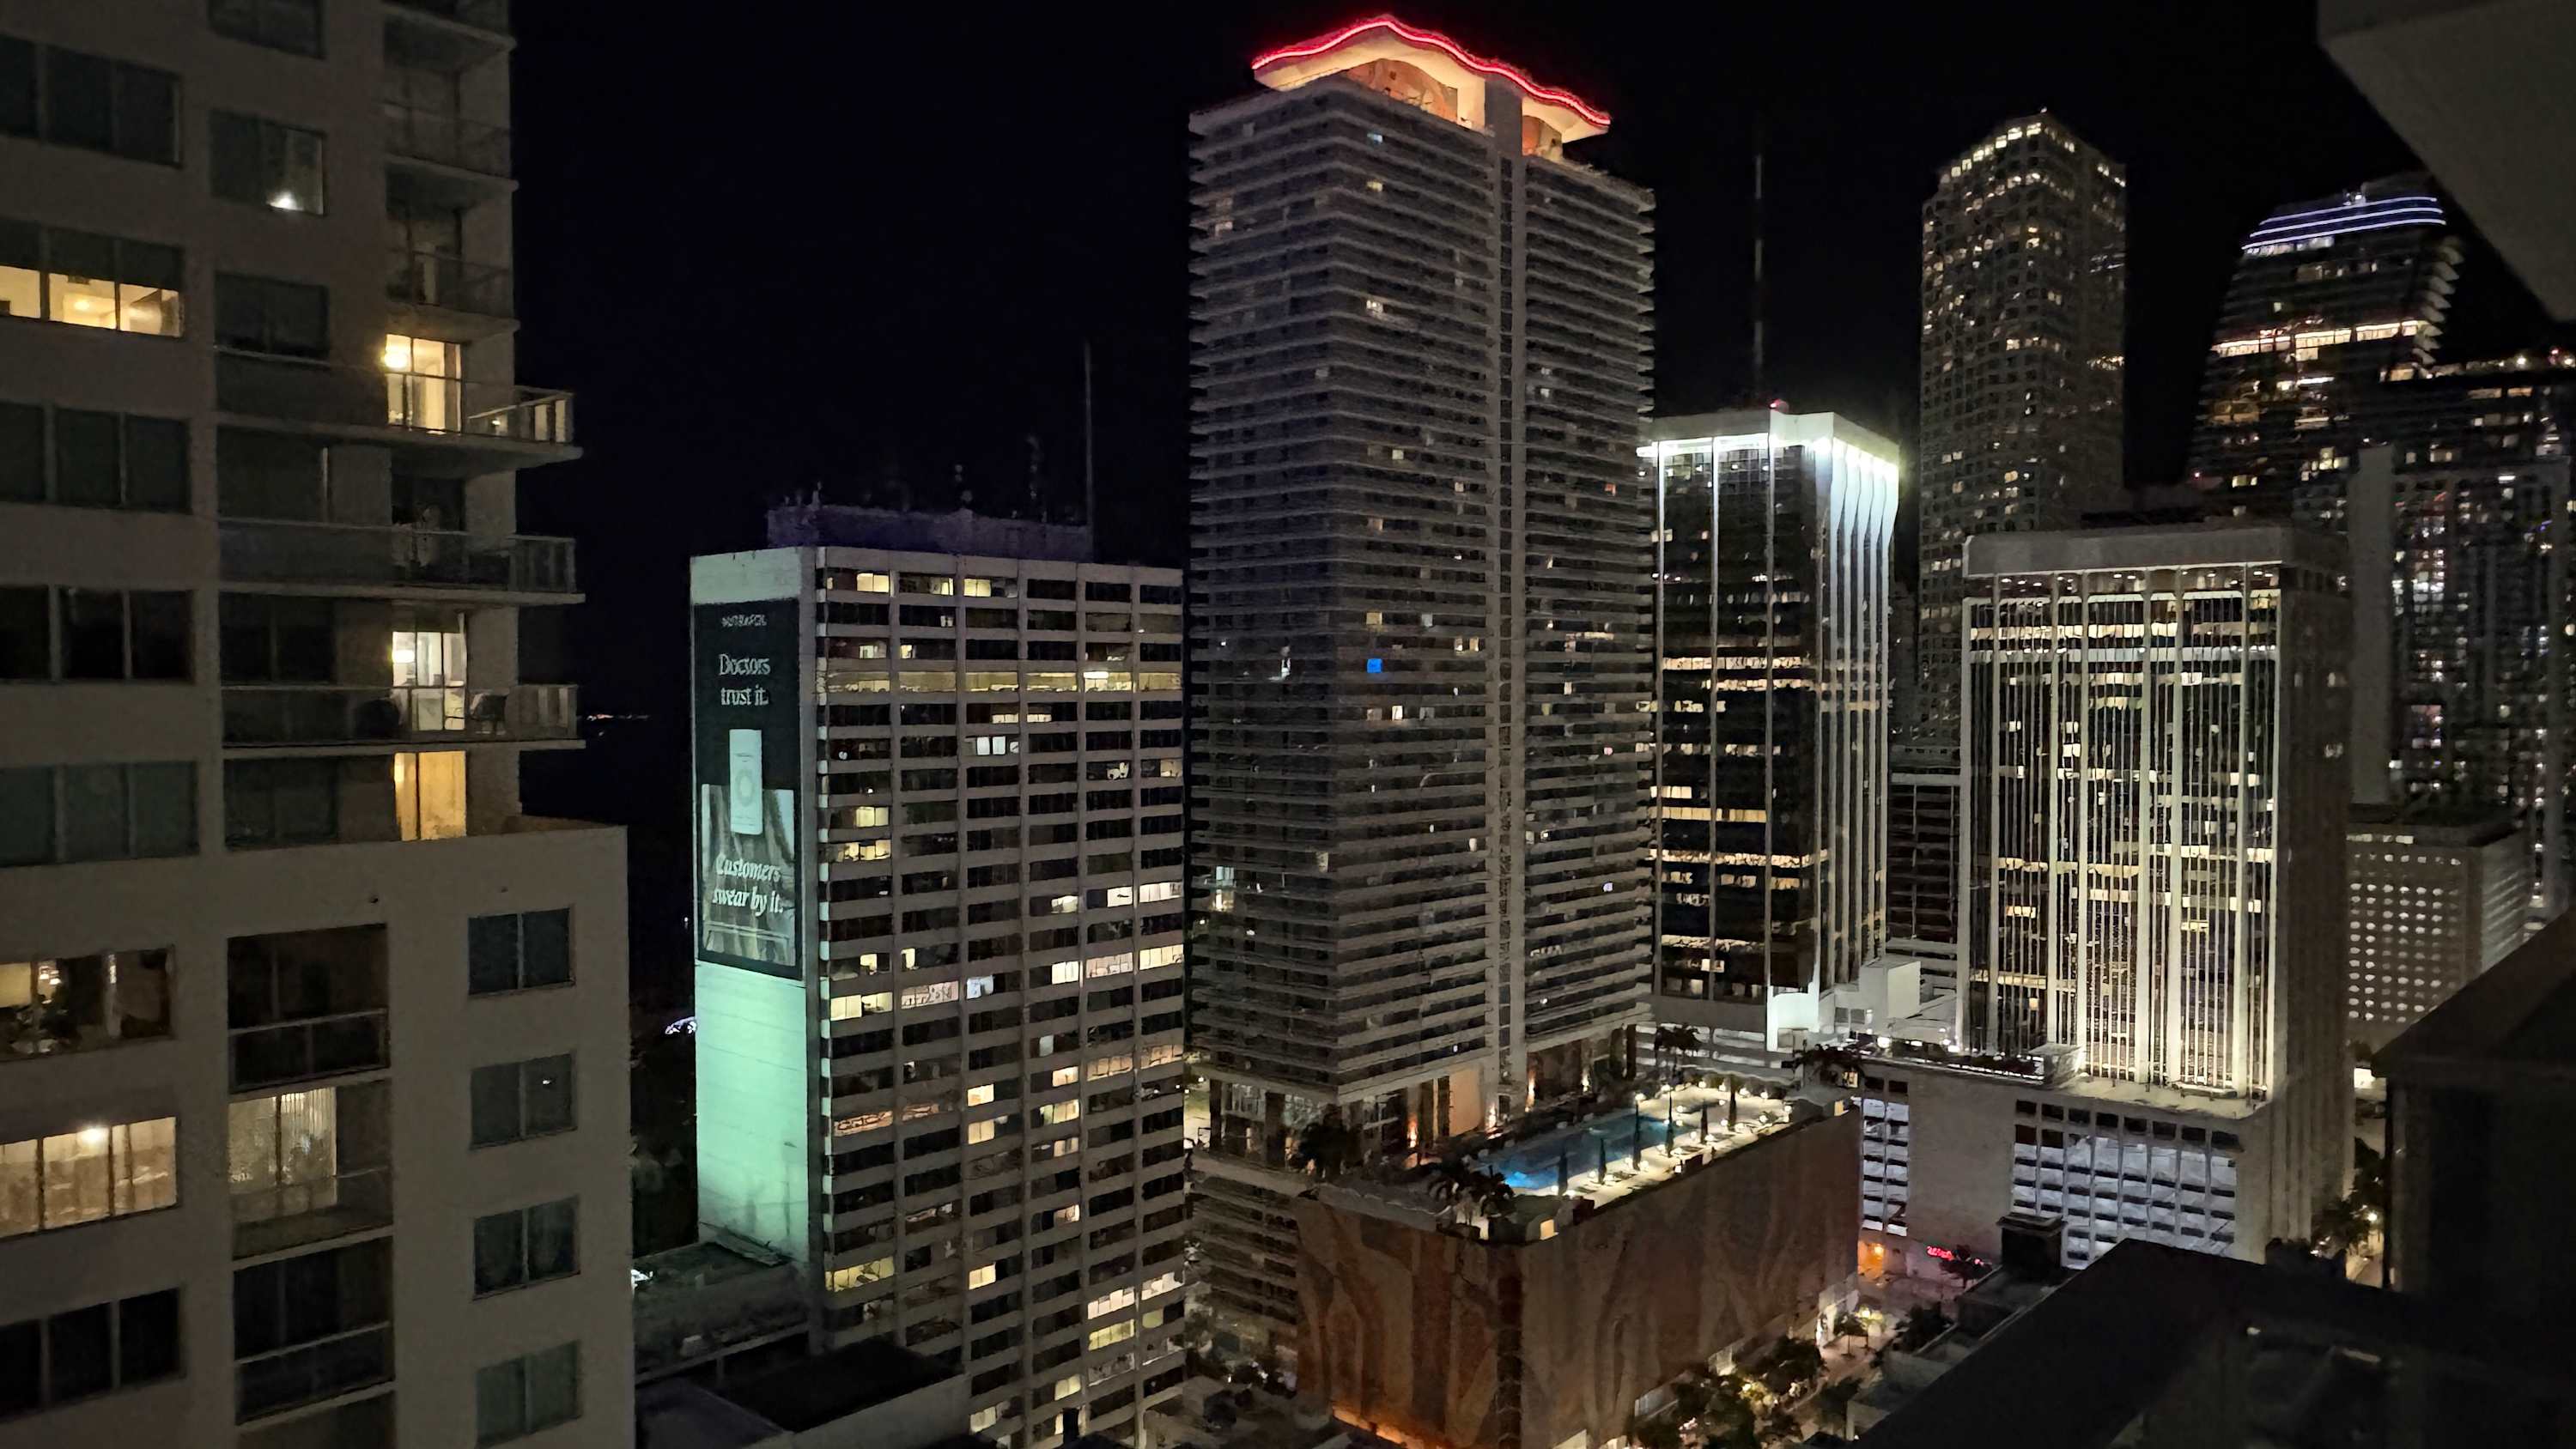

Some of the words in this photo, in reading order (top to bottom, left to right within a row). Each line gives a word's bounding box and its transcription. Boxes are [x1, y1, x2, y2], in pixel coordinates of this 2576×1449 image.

[719, 653, 771, 676] Doctors
[721, 688, 751, 706] trust
[715, 852, 781, 882] Customers
[712, 888, 750, 906] swear
[750, 886, 768, 917] by
[769, 890, 783, 912] it.
